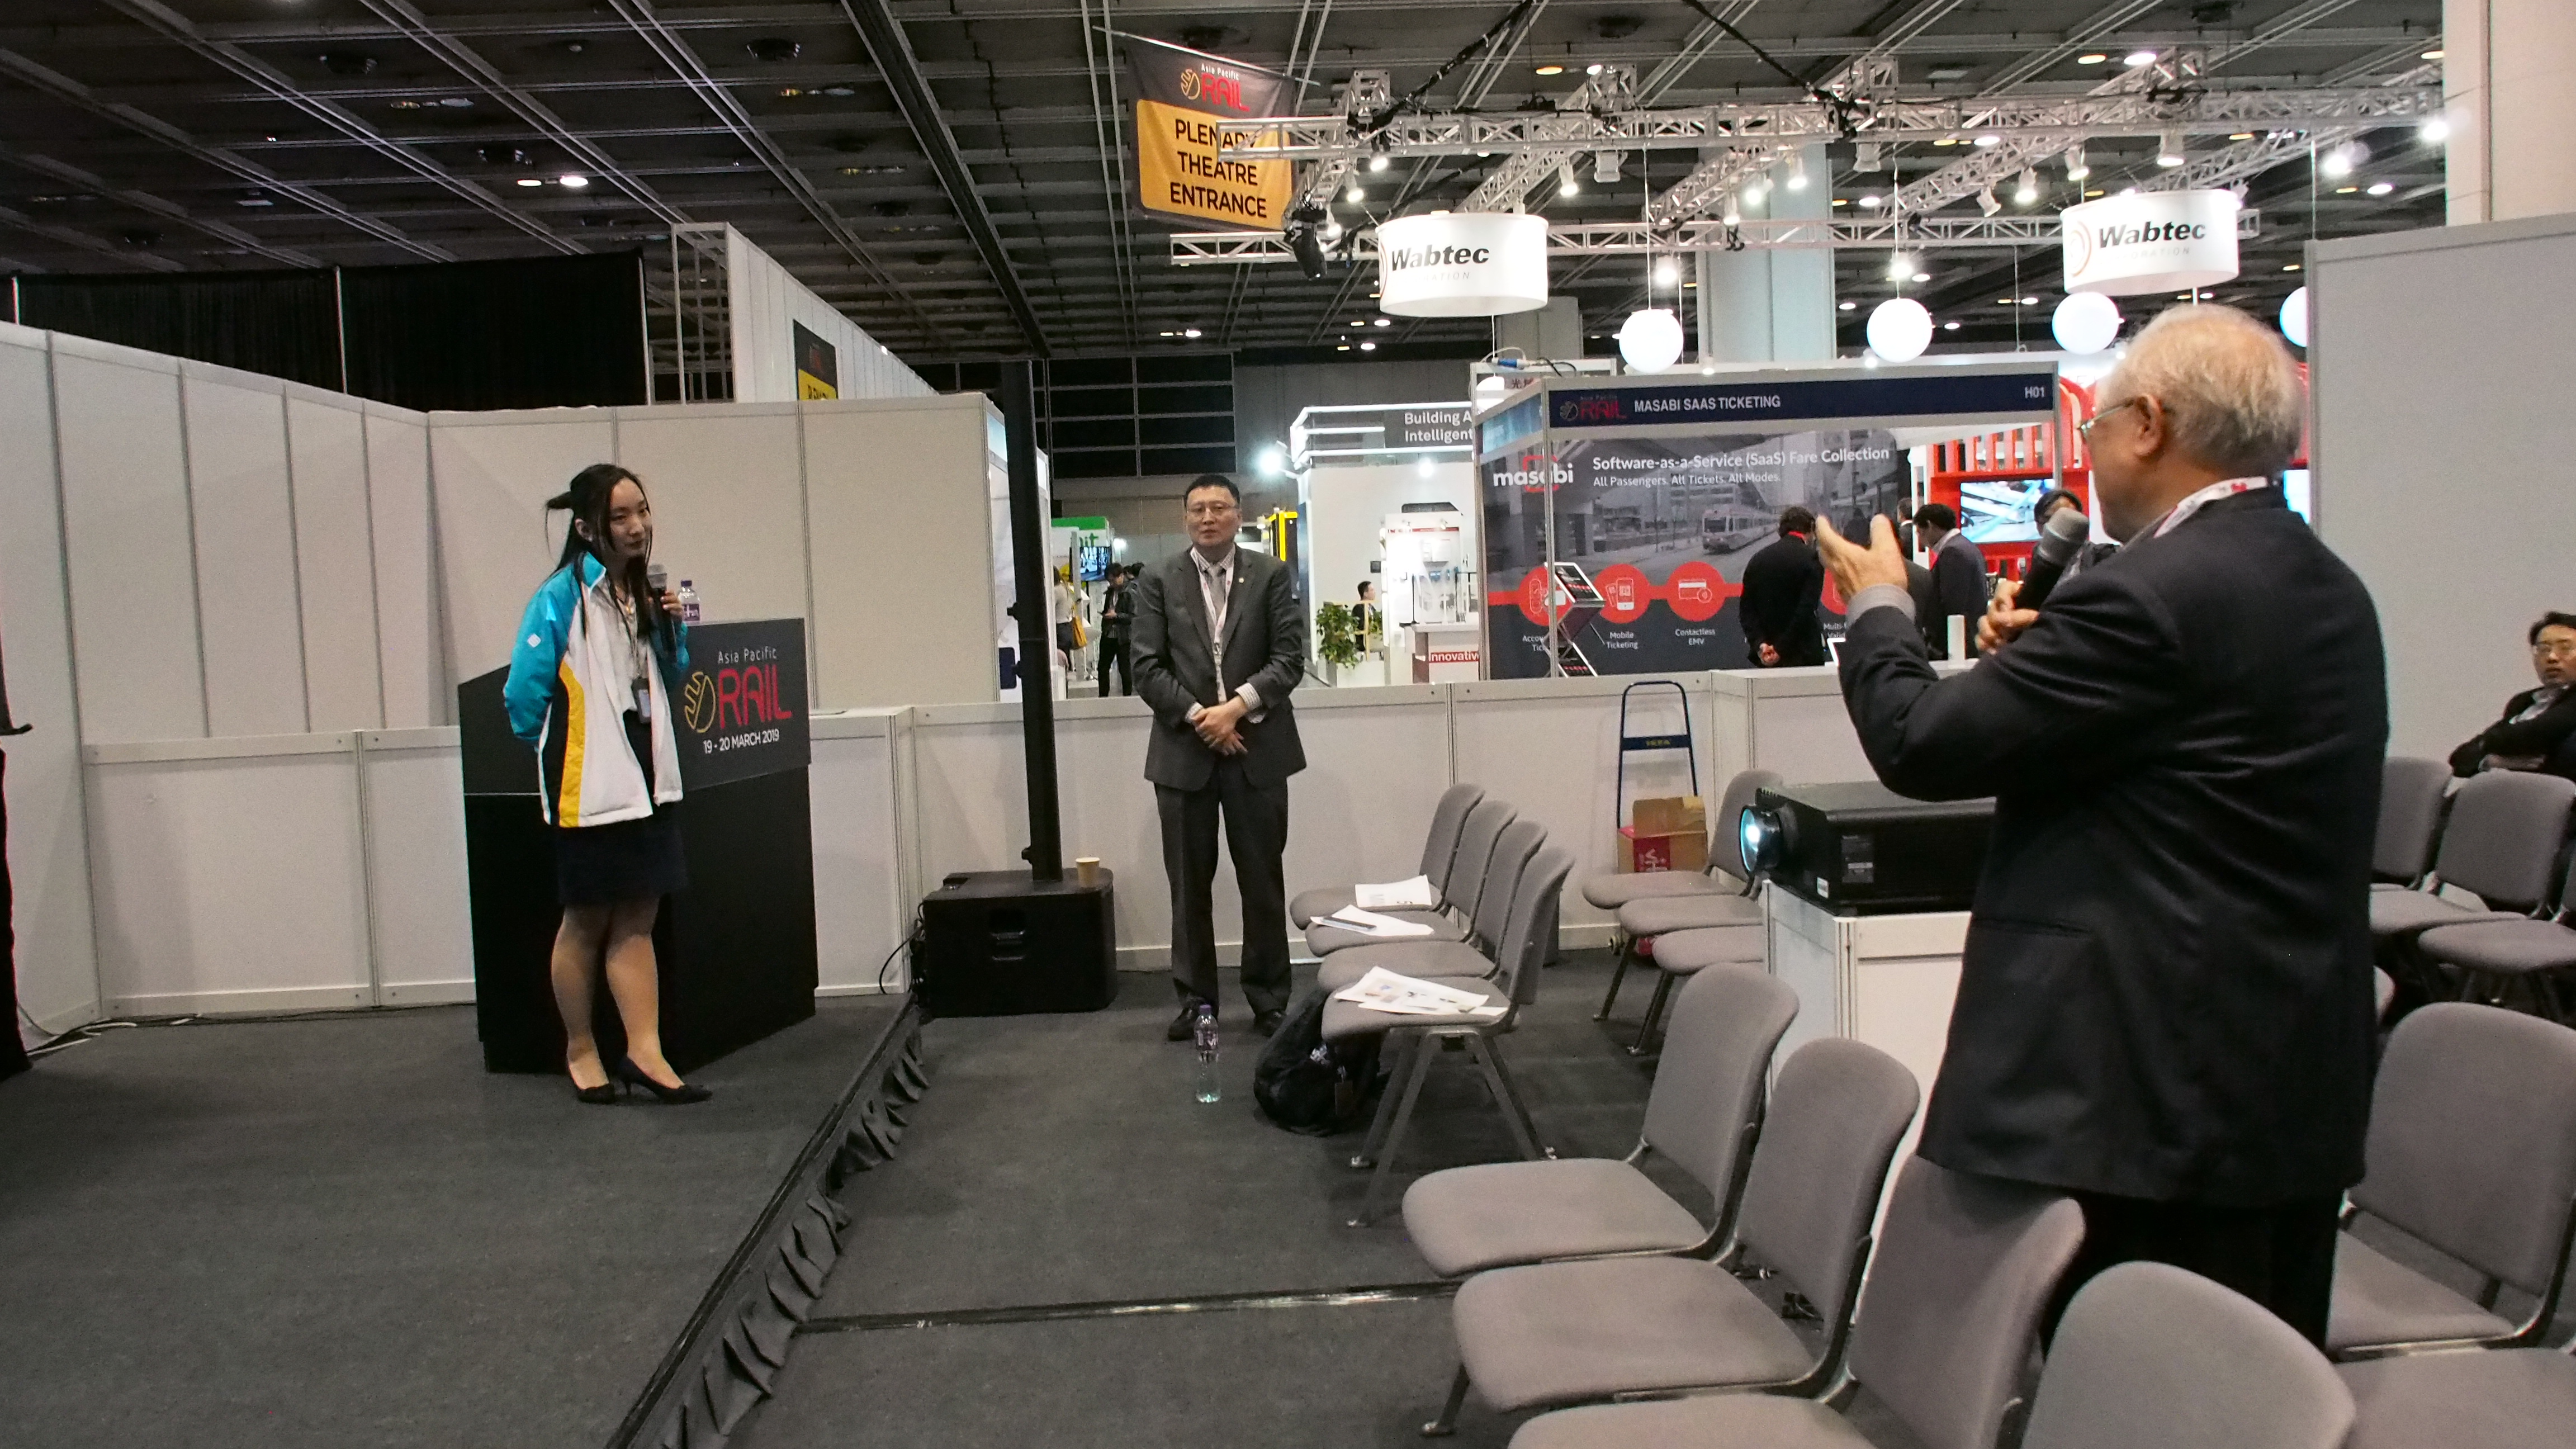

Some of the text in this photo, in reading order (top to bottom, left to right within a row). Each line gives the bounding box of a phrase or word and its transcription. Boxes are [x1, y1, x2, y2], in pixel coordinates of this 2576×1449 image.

[1201, 63, 1239, 80] Asia Pacific
[1201, 73, 1250, 112] RAIL
[1175, 119, 1256, 148] PLENAR
[1177, 151, 1258, 186] THEATRE
[1170, 182, 1267, 218] ENTRANCE
[2099, 221, 2206, 248] Wabtec
[1391, 244, 1489, 271] Wabtec
[2024, 386, 2045, 399] H01
[1580, 400, 1627, 419] RAIL
[1634, 395, 1781, 413] MASABI SAAS TICKETING
[1404, 411, 1460, 426] Building
[1405, 428, 1473, 444] Intelligent
[1593, 448, 1890, 470] Software-as-a-Service (SaaS) Fare Collection
[1593, 472, 1781, 488] All Passengers. All Tickets. All Modes.
[1675, 628, 1716, 637] Contactless
[1606, 641, 1639, 650] Ticketing
[718, 646, 777, 664] Asia Pacific
[1428, 651, 1479, 662] Innovativ
[718, 664, 793, 729] RAIL
[703, 740, 713, 754] 19
[719, 736, 730, 751] 20
[731, 731, 761, 749] MARCH
[762, 728, 780, 744] 2019
